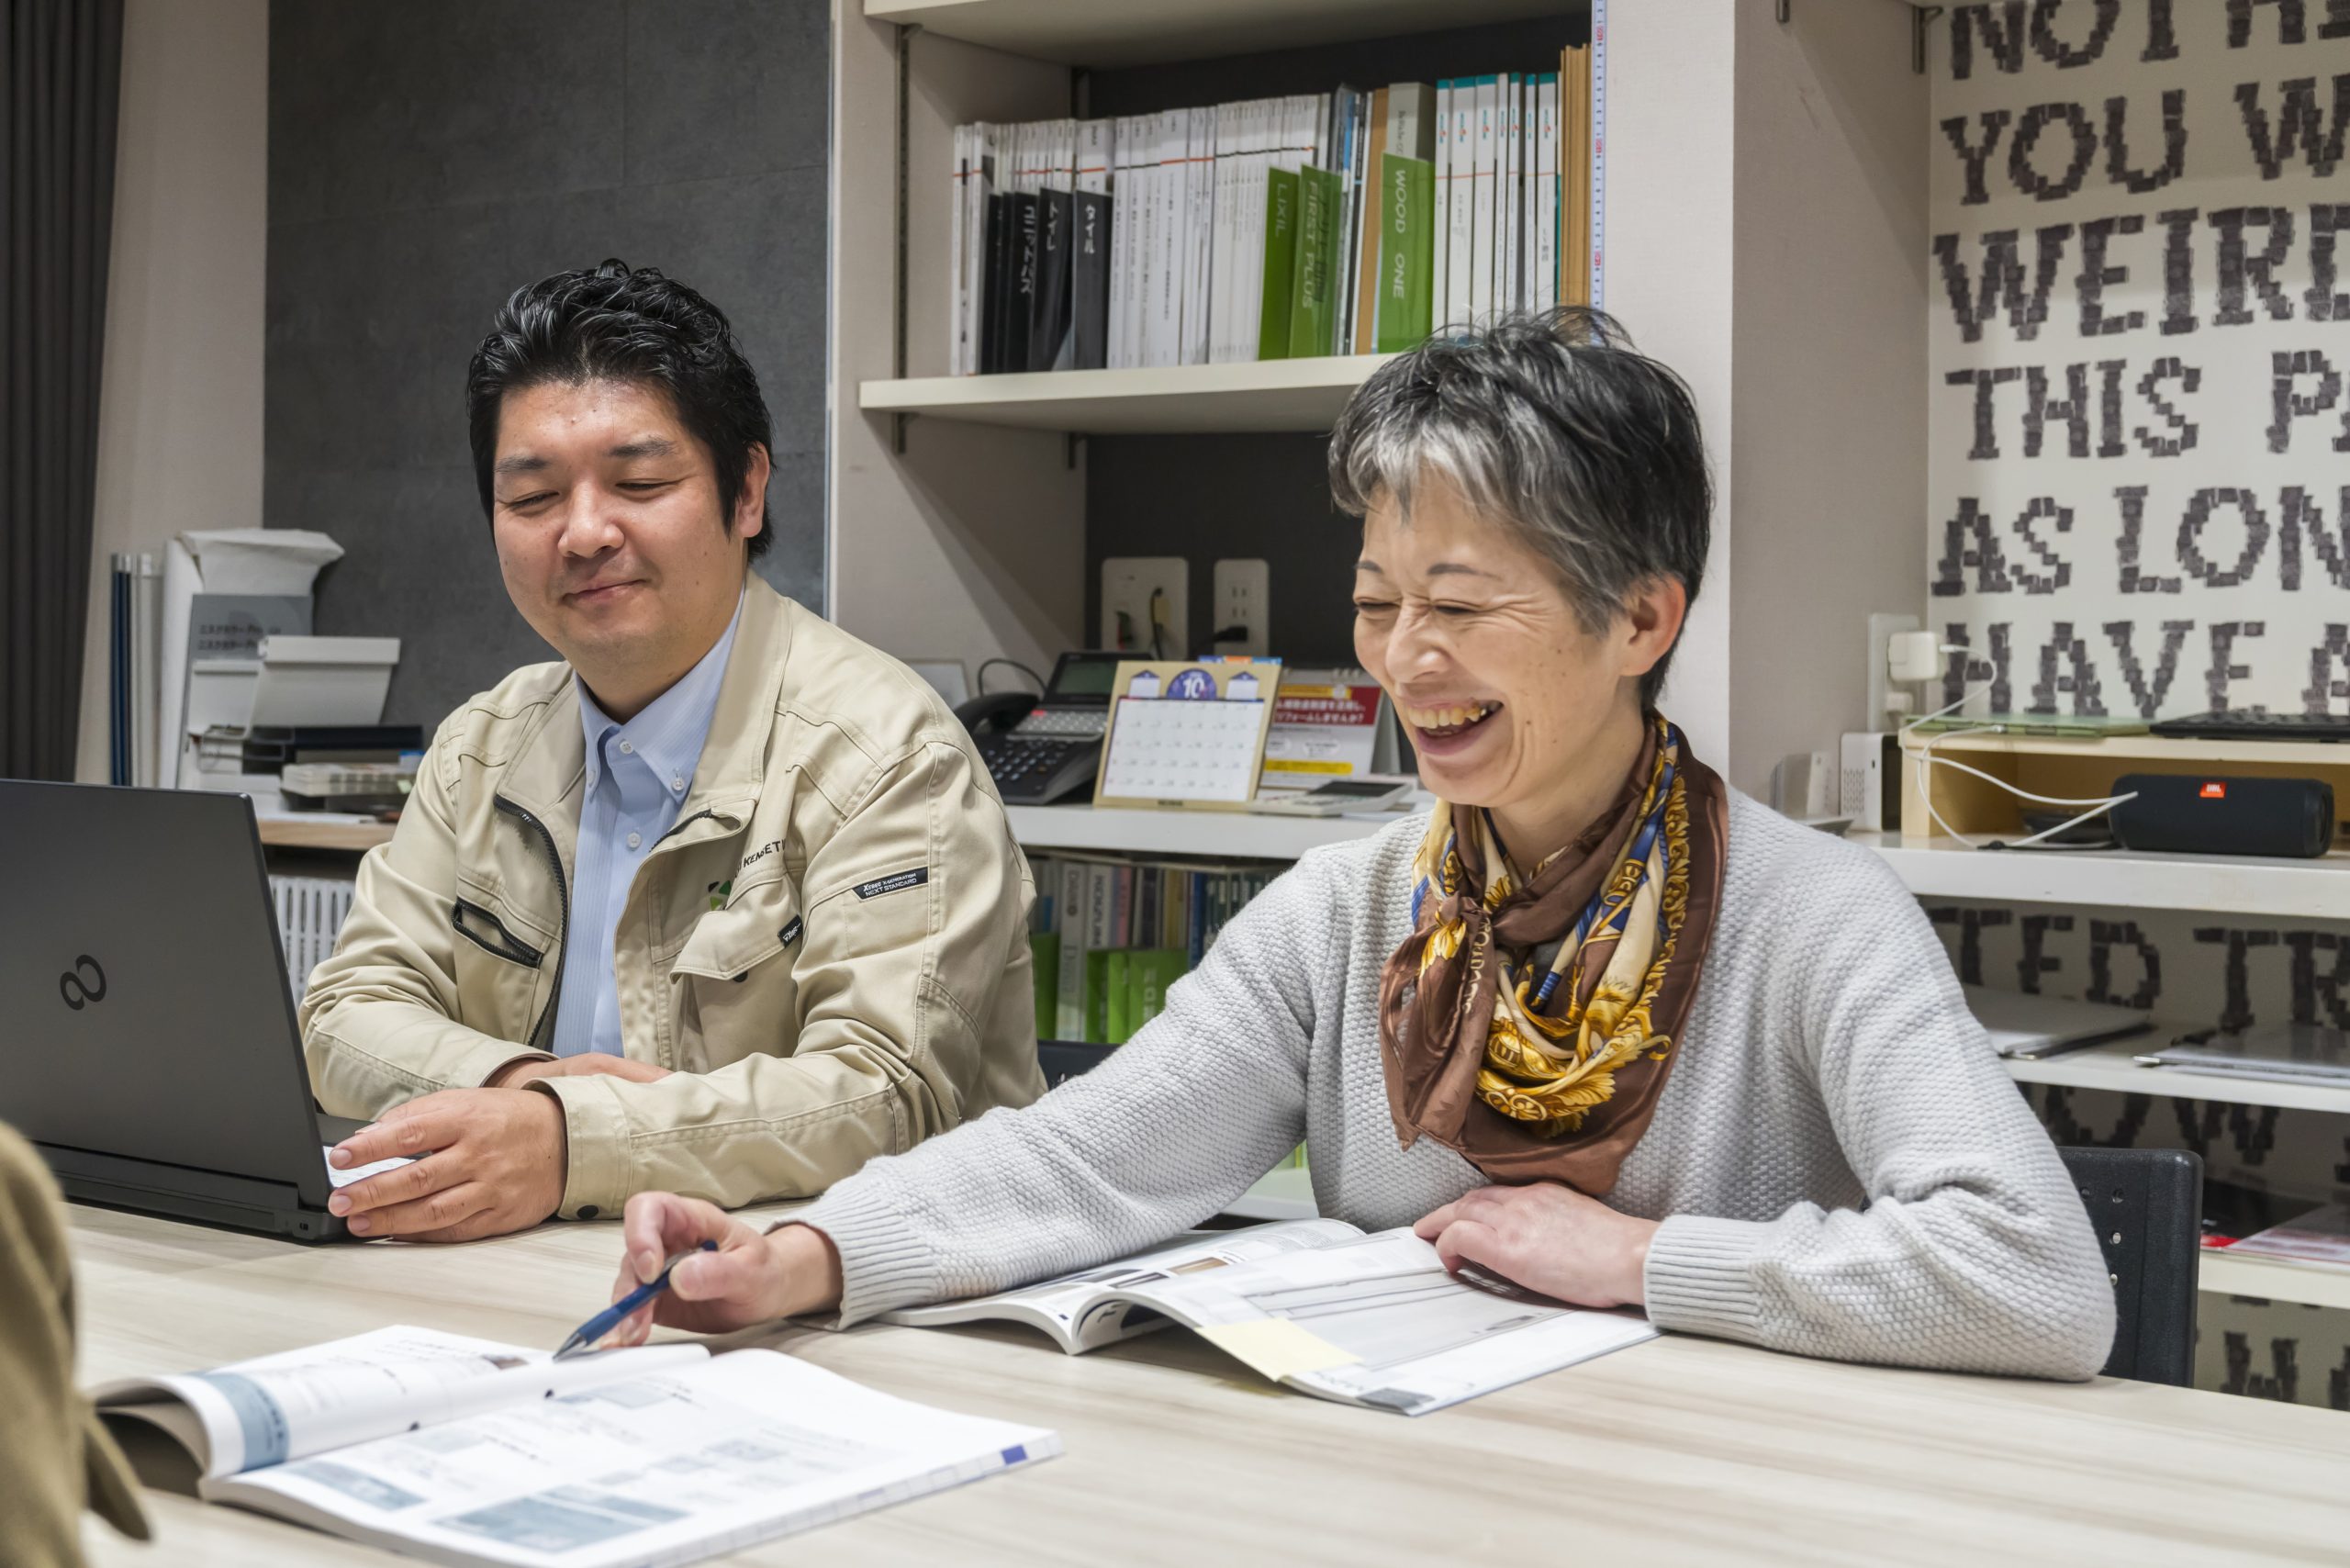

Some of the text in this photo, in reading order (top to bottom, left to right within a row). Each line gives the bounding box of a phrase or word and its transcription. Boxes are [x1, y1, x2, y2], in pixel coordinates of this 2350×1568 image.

[1941, 89, 2187, 205] YOU
[1046, 201, 1059, 252] トイレ
[1084, 203, 1096, 255] タイル
[1274, 182, 1288, 238] LIXIL
[1394, 169, 1407, 234] WOOD
[1302, 252, 1315, 309] PLUS
[1393, 252, 1405, 299] ONE
[1945, 356, 2202, 460] THIS
[1930, 497, 2075, 598] AS
[1182, 678, 1205, 699] 10
[1943, 621, 2266, 719] HAVE
[865, 878, 917, 897] NEXT STANDARD
